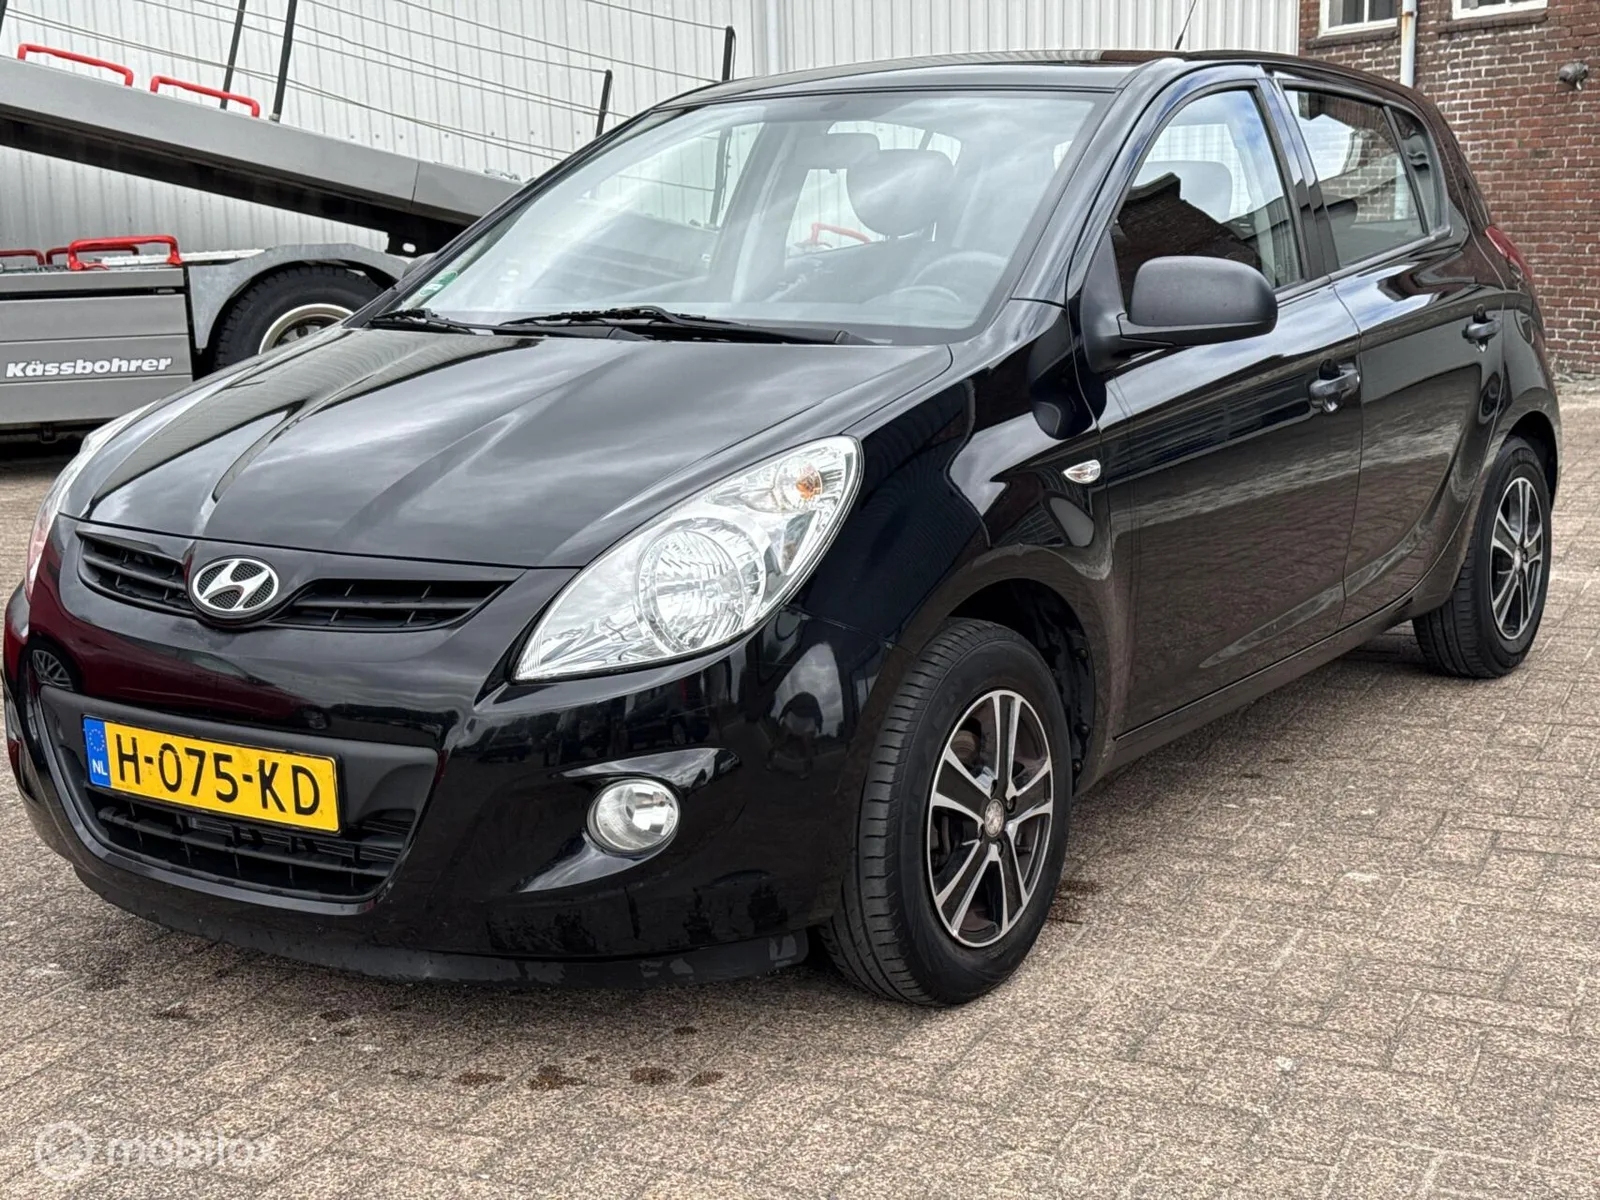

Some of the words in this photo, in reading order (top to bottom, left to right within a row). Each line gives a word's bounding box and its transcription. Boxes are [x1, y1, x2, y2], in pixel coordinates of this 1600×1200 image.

[6, 357, 172, 378] Kässbohrer
[92, 758, 108, 776] NL
[115, 733, 321, 816] H-075-KD
